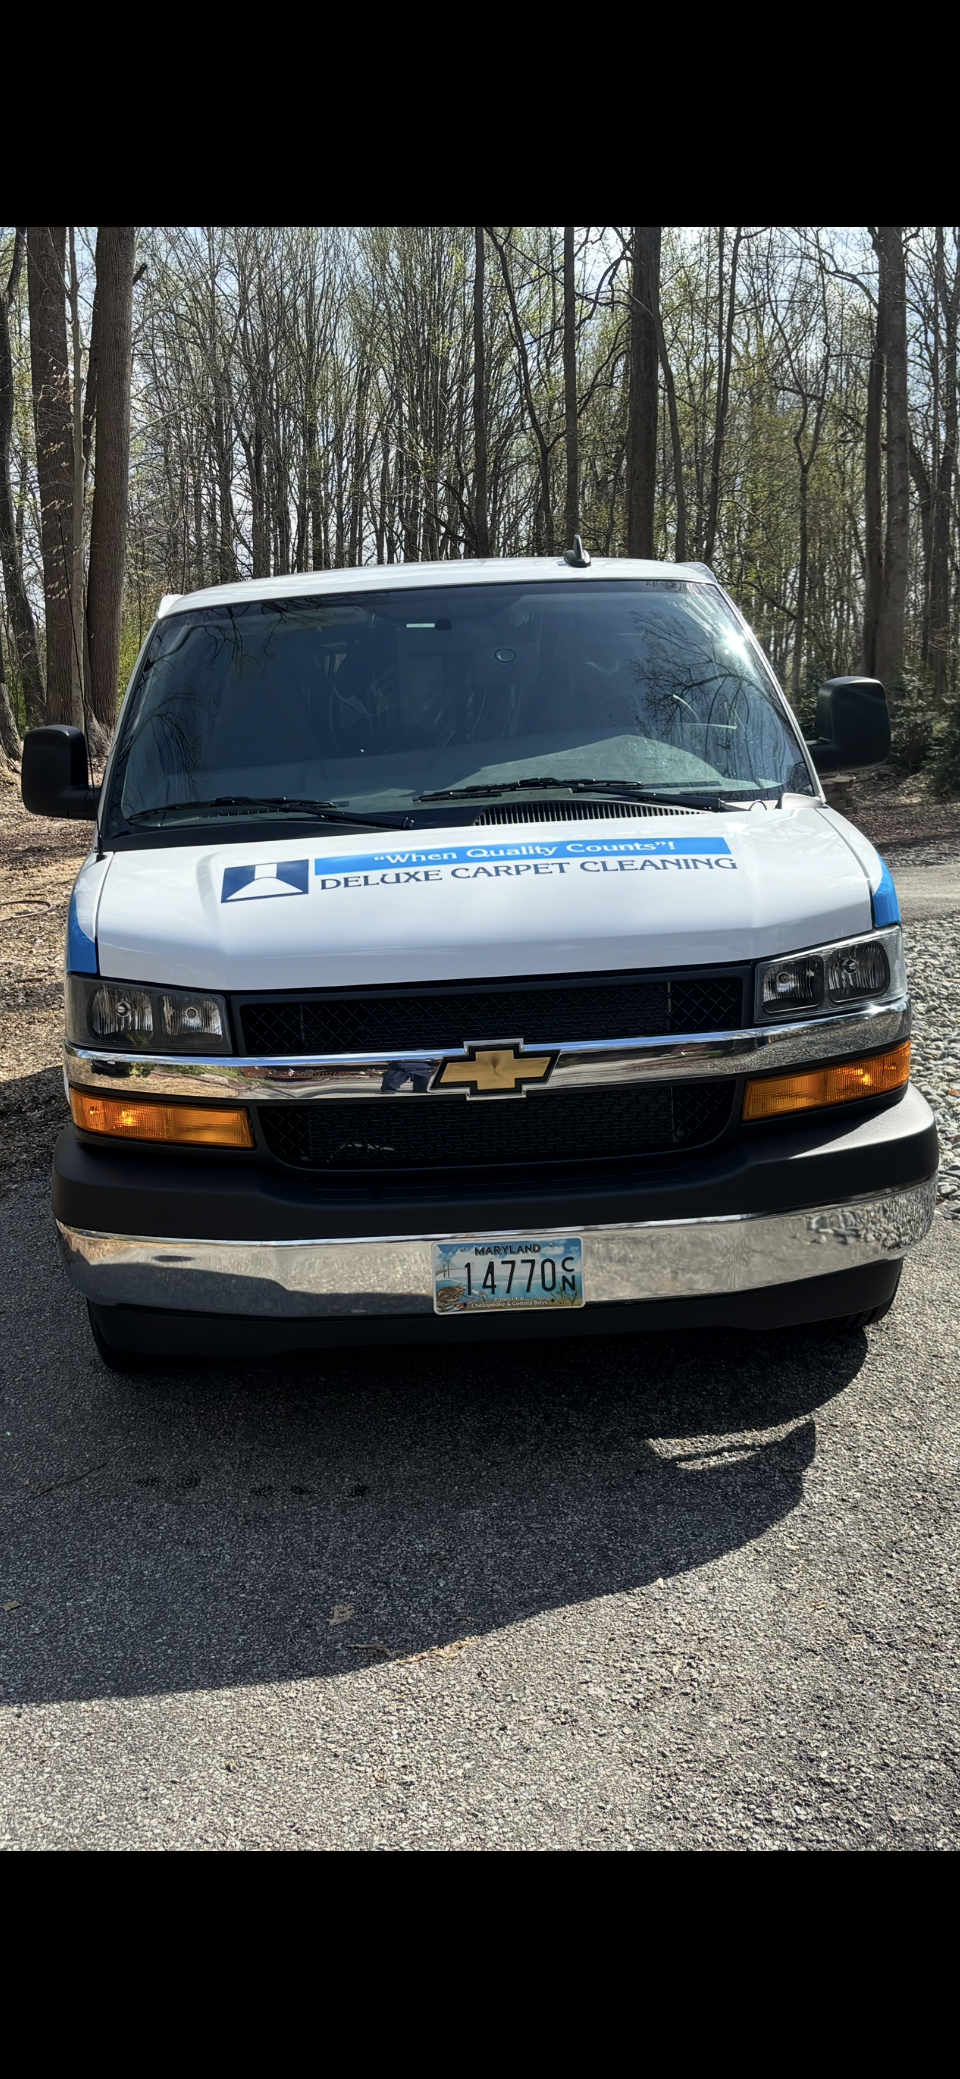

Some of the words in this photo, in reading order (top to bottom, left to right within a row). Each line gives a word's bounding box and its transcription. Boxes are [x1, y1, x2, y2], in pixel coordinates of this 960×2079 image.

[466, 845, 558, 859] Quality
[320, 869, 443, 890] DELUXE
[450, 862, 571, 879] CARPET
[579, 857, 738, 873] CLEANING
[475, 1243, 541, 1256] MARYLAND
[464, 1258, 556, 1296] 14770
